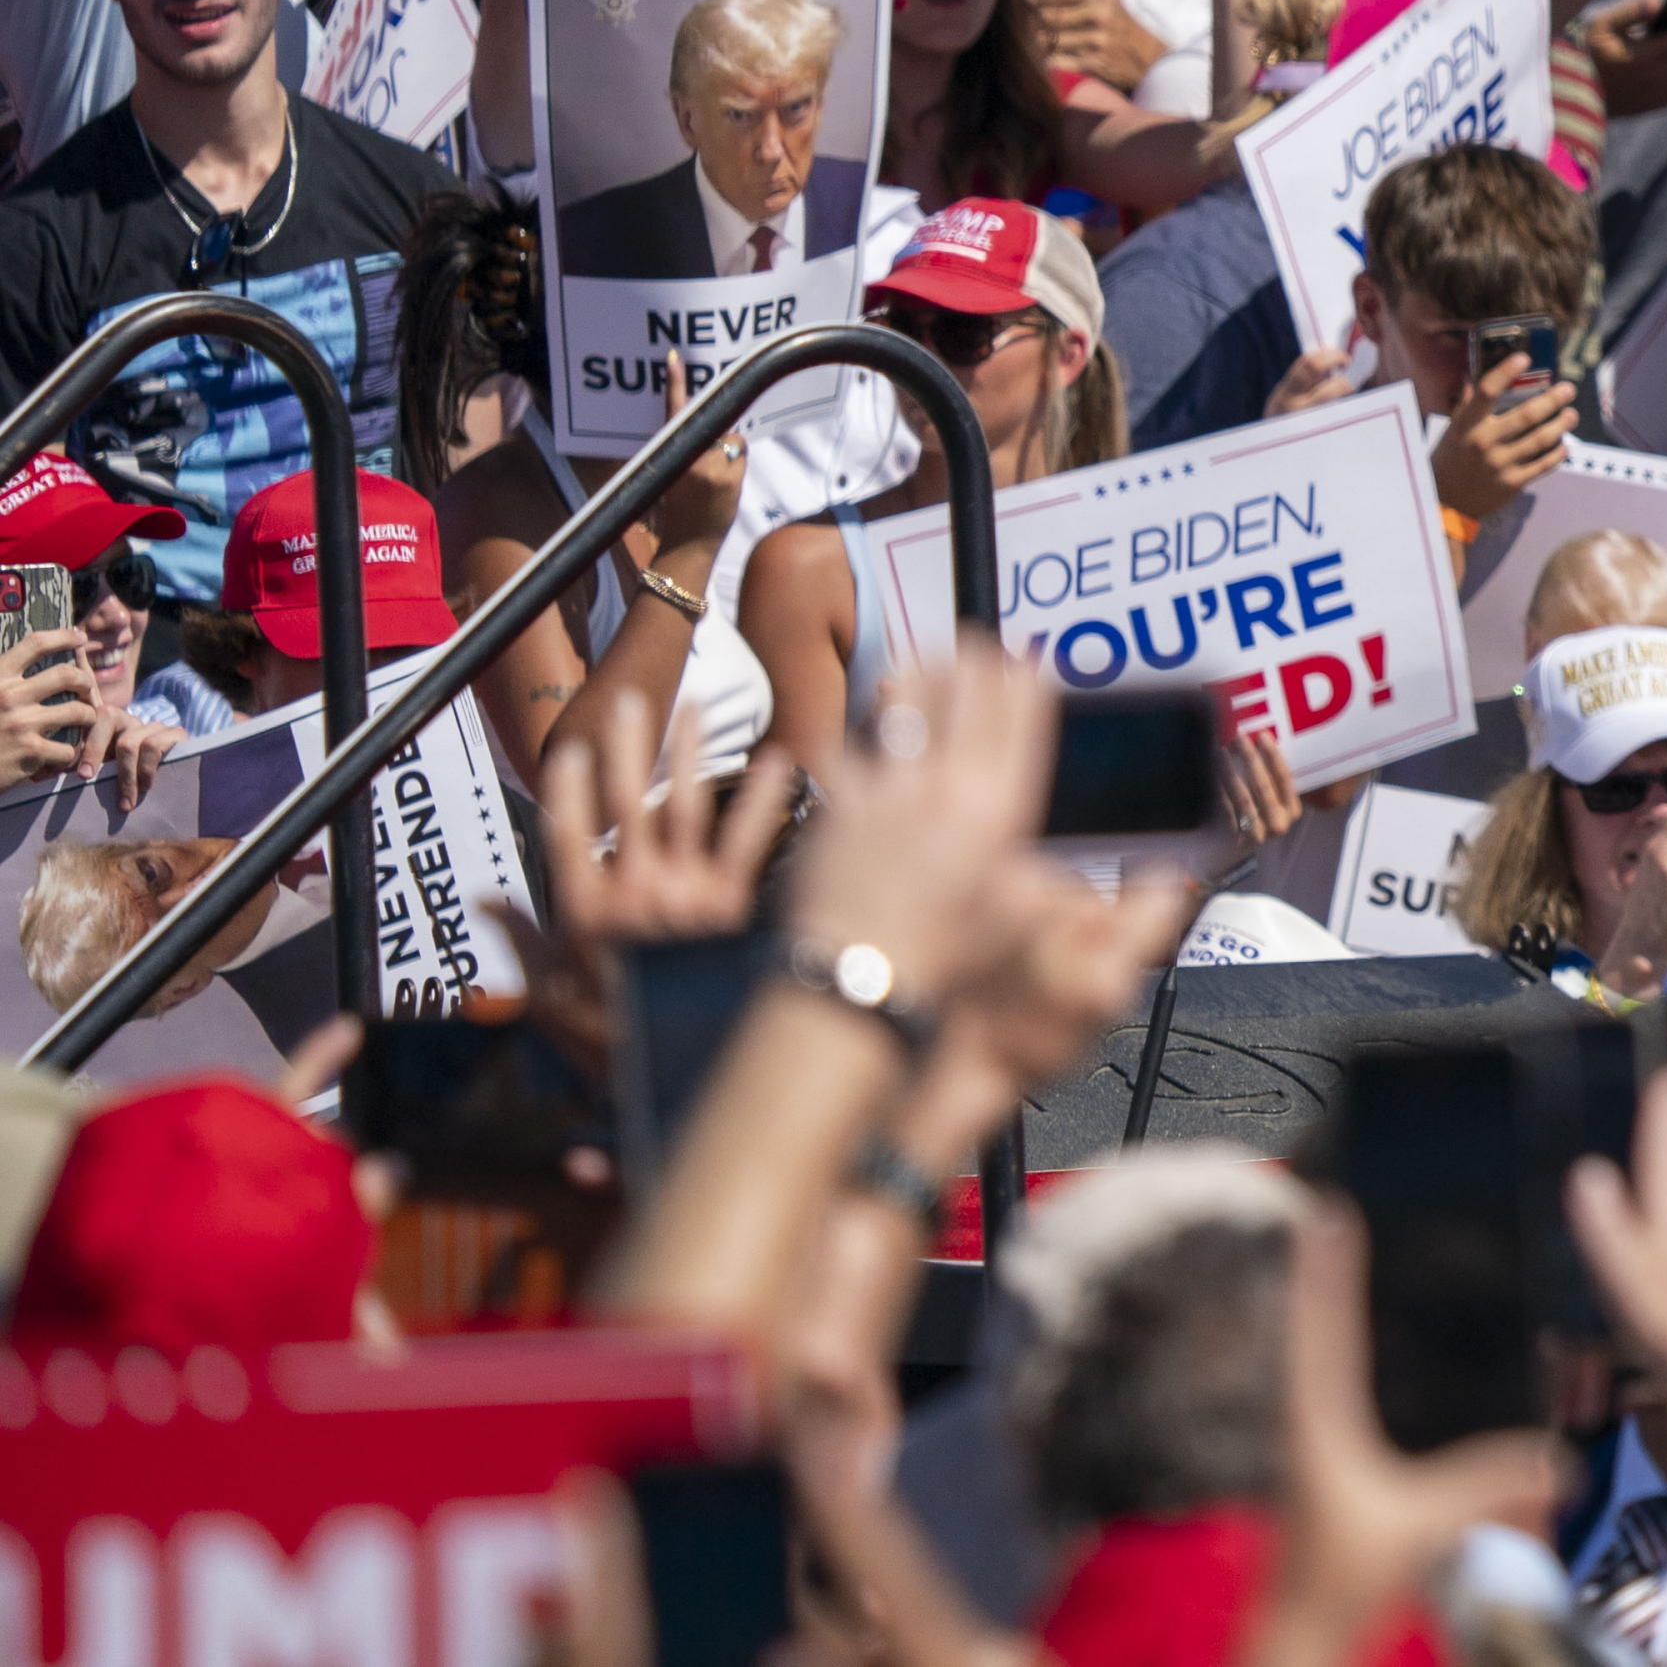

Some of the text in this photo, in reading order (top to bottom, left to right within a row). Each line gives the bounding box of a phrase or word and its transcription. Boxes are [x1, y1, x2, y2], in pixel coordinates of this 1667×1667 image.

[1332, 97, 1401, 201] JOE
[646, 295, 797, 347] NEVER
[358, 522, 419, 543] MERICA
[364, 544, 416, 564] AGAIN
[1000, 481, 1324, 619] JOE BIDEN,
[1208, 631, 1396, 745] ED!
[371, 784, 421, 972] NEV
[387, 734, 480, 996] URRENDE
[1219, 933, 1262, 961] GO
